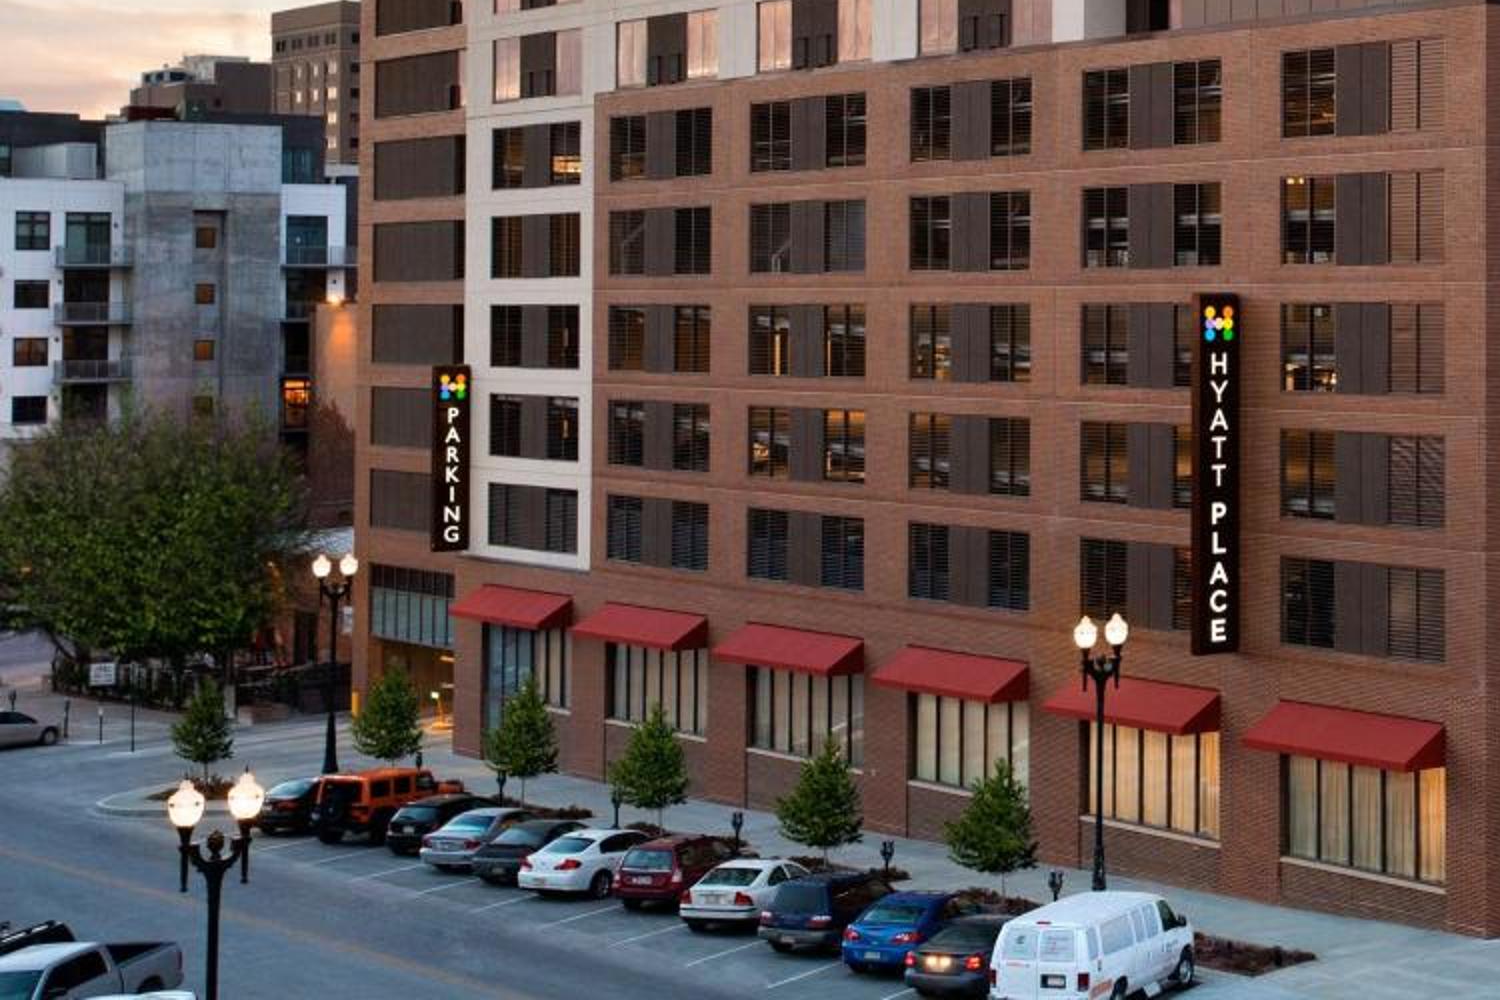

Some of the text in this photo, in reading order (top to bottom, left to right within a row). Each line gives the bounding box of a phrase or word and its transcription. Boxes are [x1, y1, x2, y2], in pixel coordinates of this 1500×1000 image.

[443, 407, 461, 543] PARKING
[1209, 352, 1229, 643] HYATT PLACE
